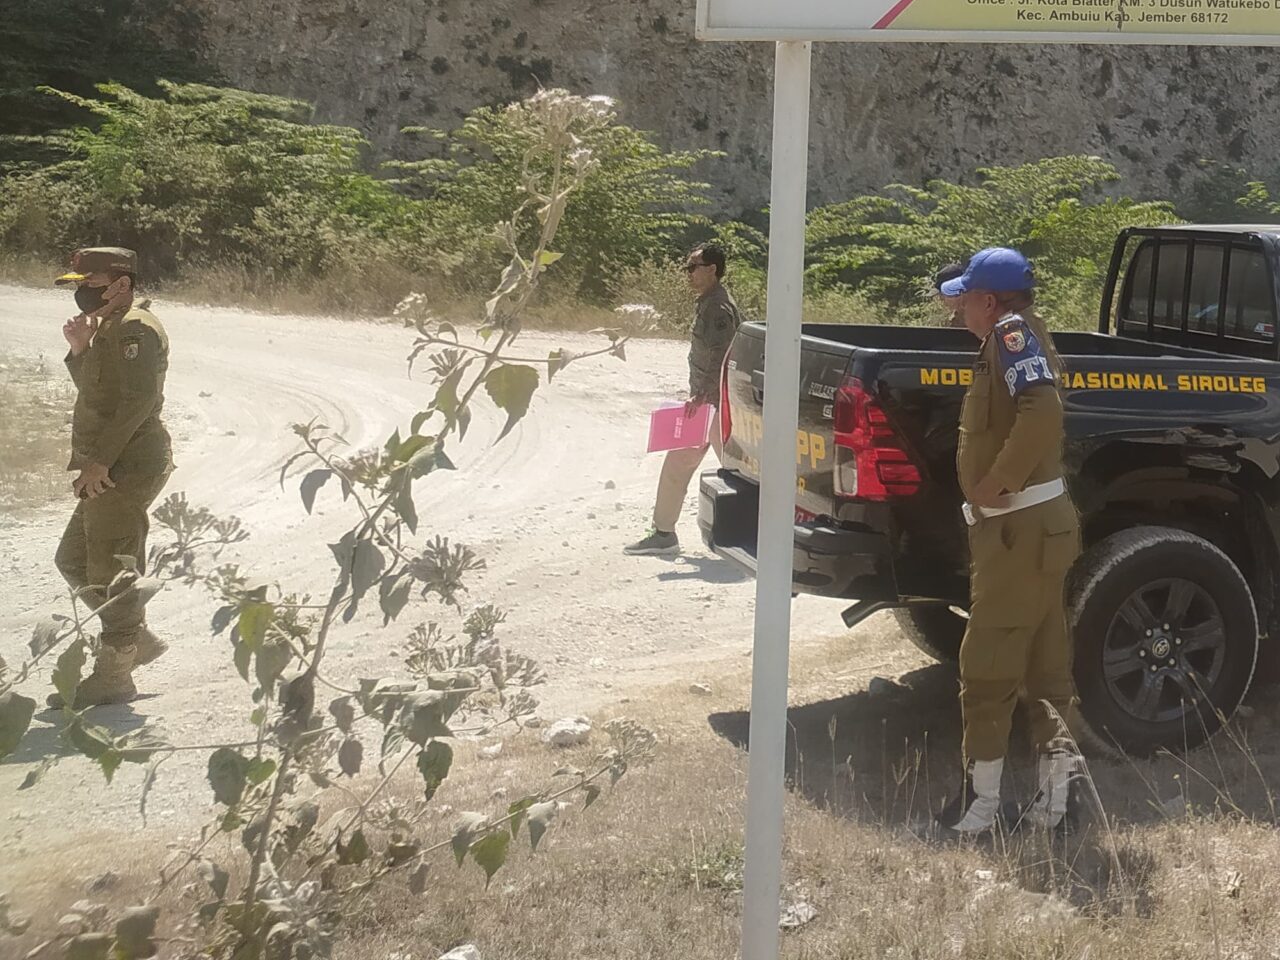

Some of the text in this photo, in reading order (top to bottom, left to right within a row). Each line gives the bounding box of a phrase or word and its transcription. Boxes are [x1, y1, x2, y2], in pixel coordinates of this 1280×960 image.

[1016, 9, 1046, 22] Kec.
[1137, 12, 1187, 24] Jember
[1190, 13, 1229, 24] 68172
[920, 368, 1266, 393] MOB RASIONAL SIROLEG
